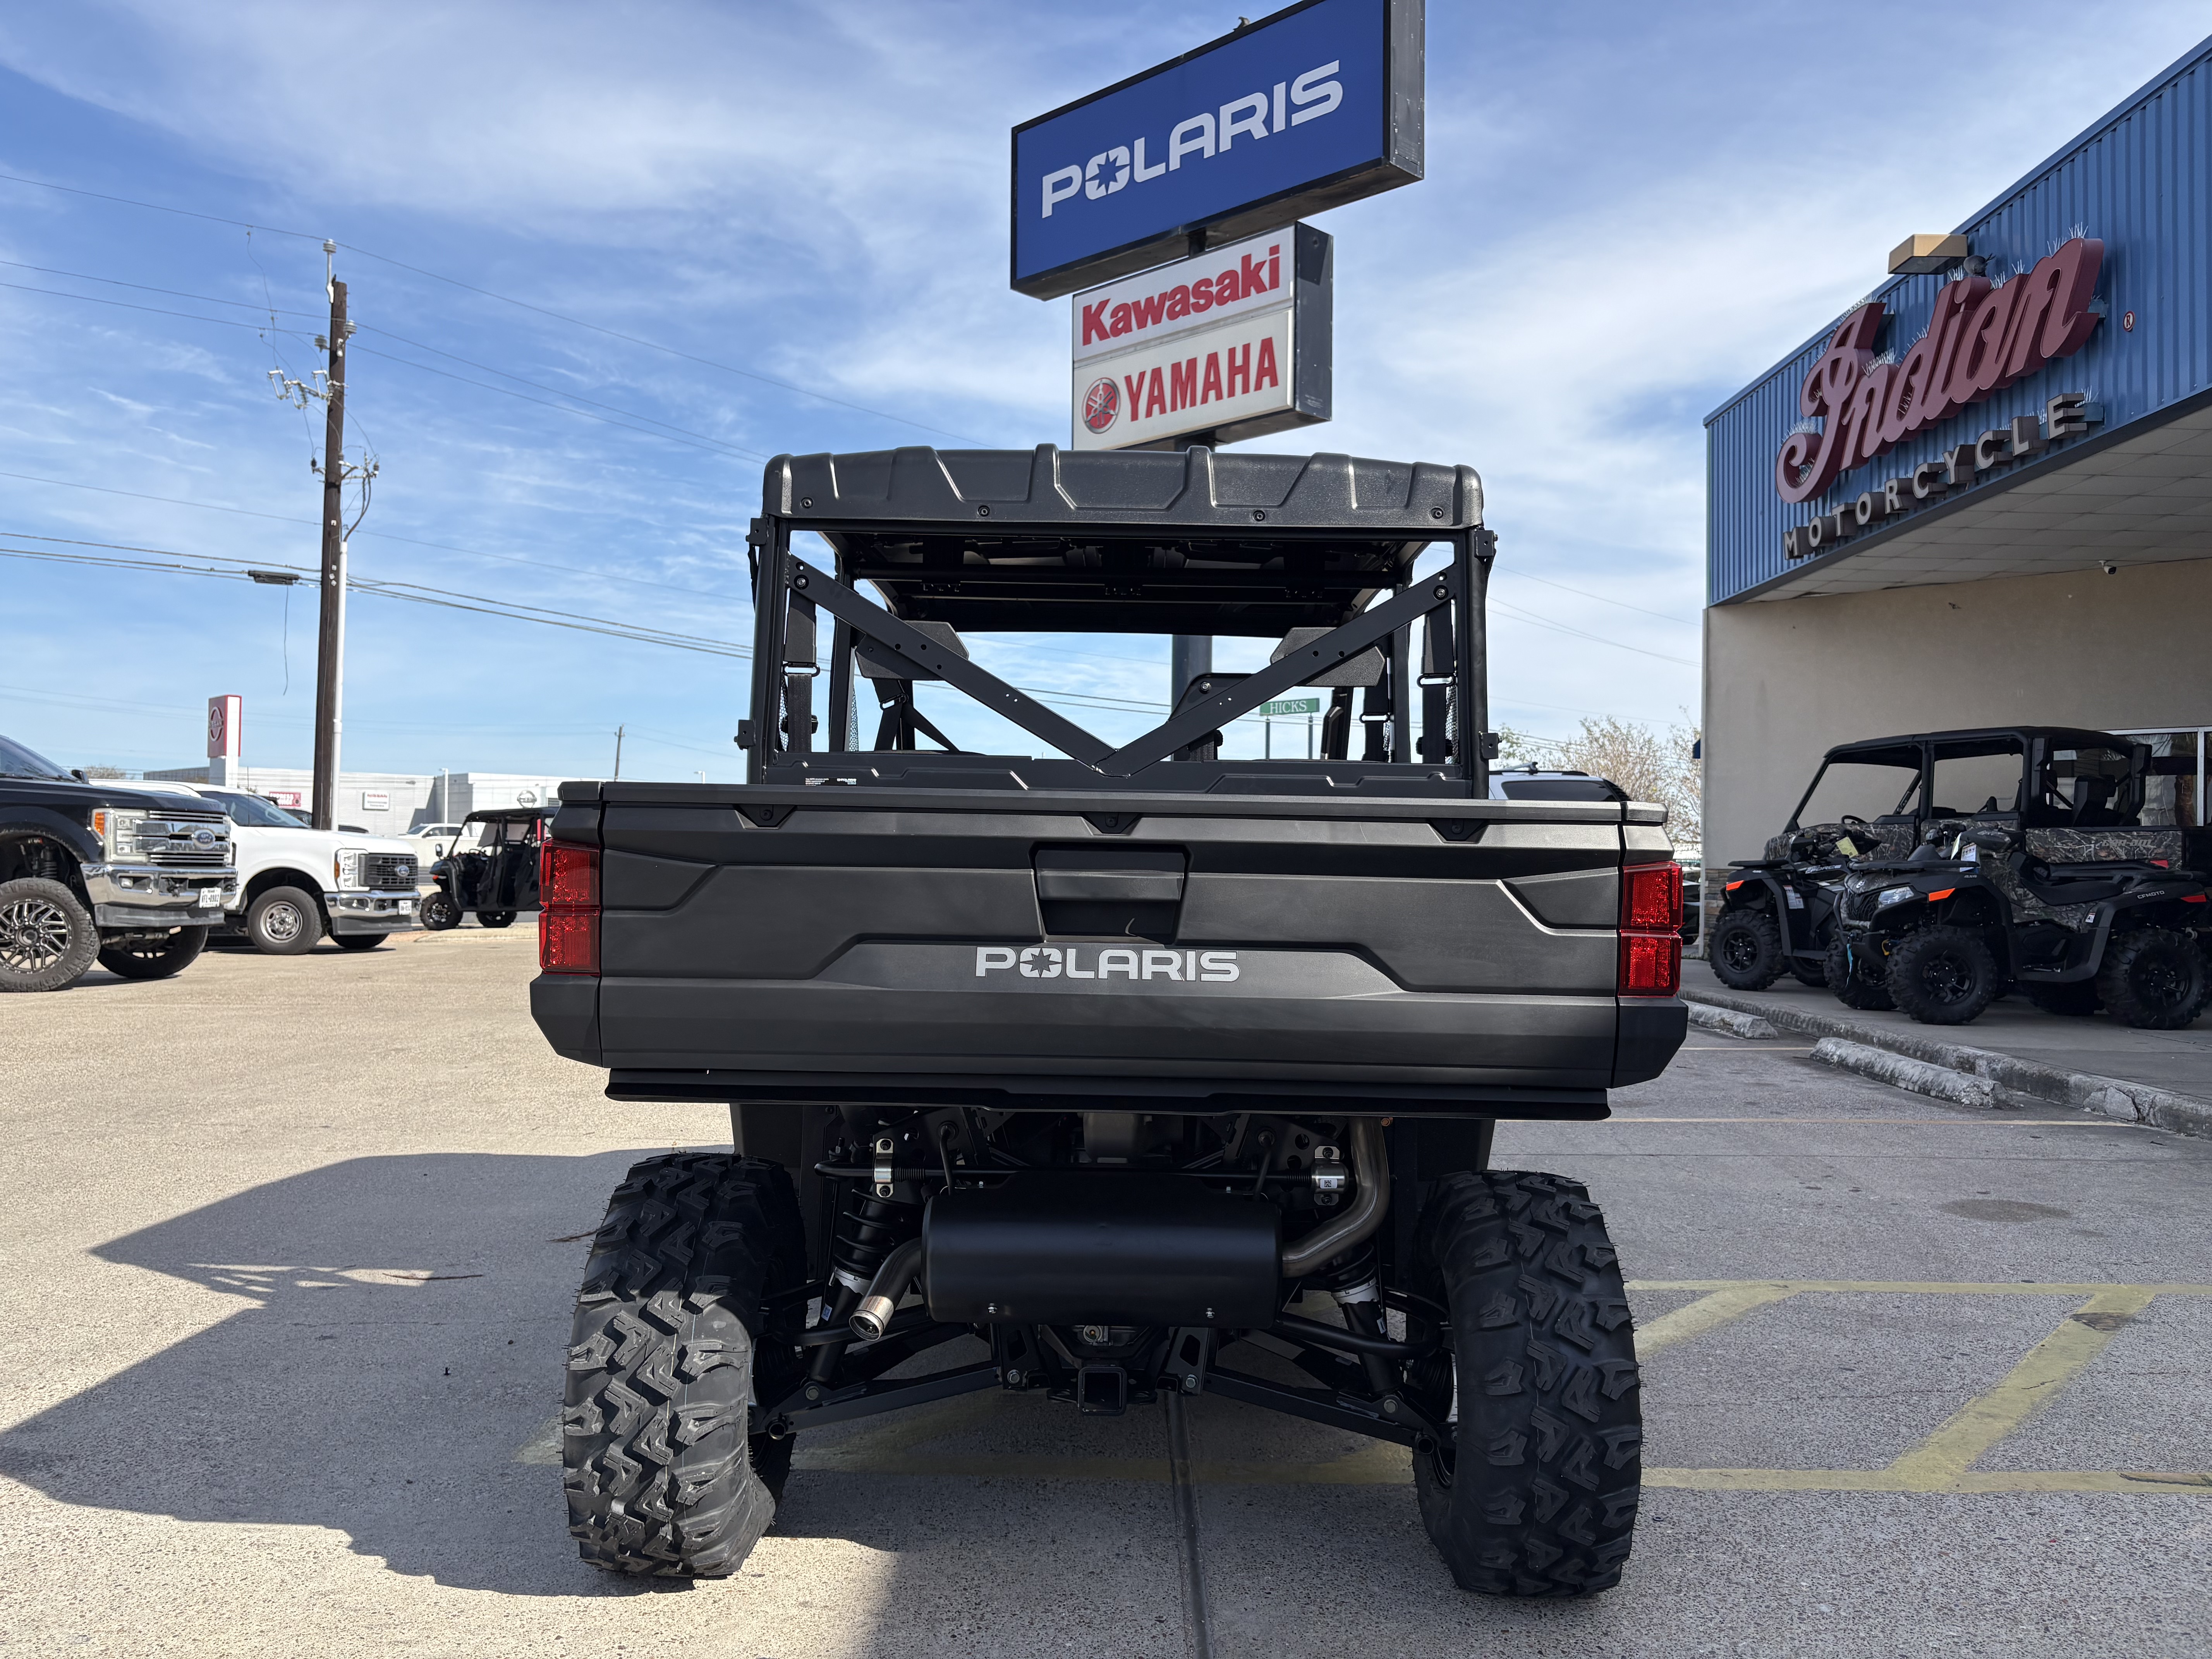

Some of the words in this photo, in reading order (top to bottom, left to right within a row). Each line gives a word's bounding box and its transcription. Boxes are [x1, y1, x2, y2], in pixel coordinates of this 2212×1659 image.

[1042, 60, 1343, 218] POLARIS
[1082, 244, 1280, 346] Kawasaki
[1124, 337, 1279, 421] YAMAHA
[1776, 238, 2104, 503] Indian
[1783, 393, 2088, 560] MOTORCYCLE
[1269, 701, 1307, 714] HICKS
[2137, 890, 2165, 899] CFMOTO
[975, 946, 1241, 982] POLARIS
